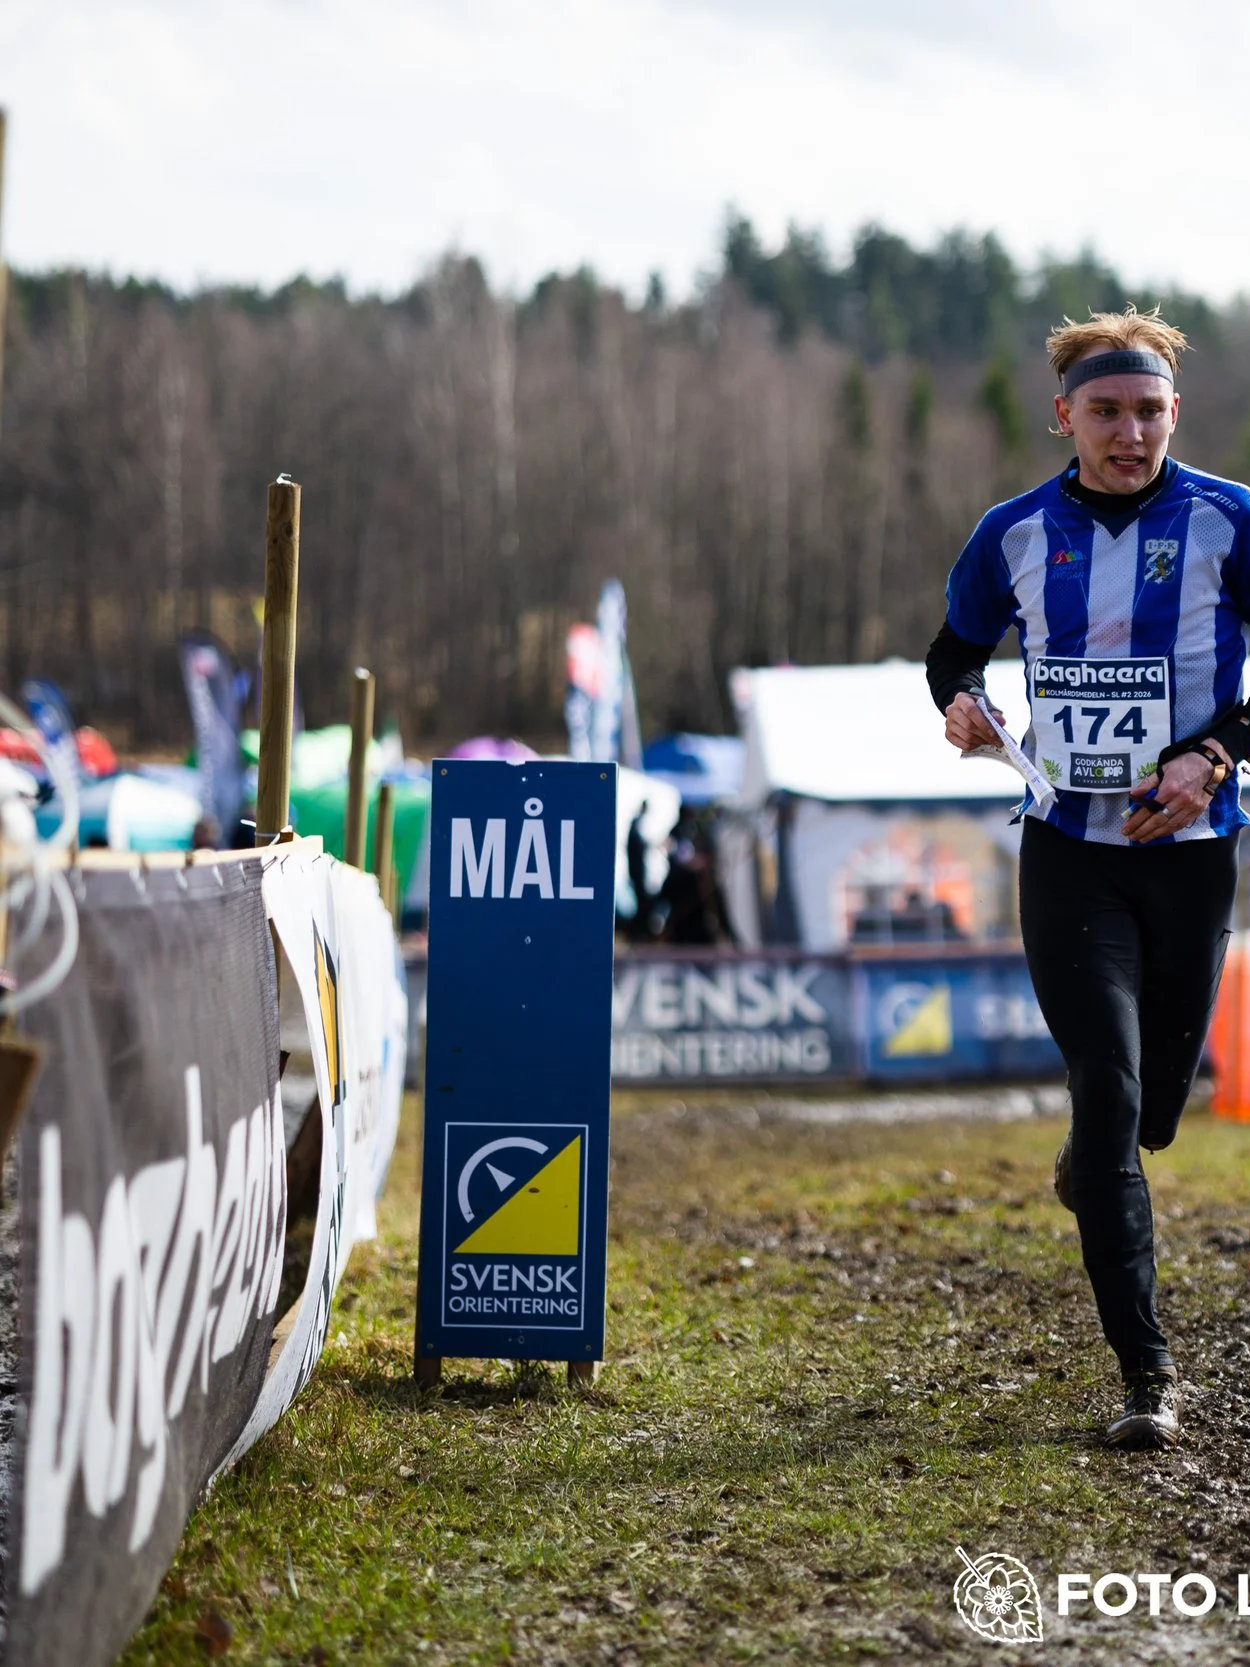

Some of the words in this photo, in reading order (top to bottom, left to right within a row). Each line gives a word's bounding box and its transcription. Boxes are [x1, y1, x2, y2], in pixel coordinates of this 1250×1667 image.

[1035, 661, 1163, 686] bagheera
[1046, 689, 1105, 698] KOLMÅRDSMEDELN
[1054, 705, 1147, 745] 174
[1074, 766, 1124, 778] AVLOPP
[1075, 758, 1124, 767] GODKÄNDA
[450, 797, 594, 900] MÅL
[613, 963, 827, 1029] VENSK
[450, 1263, 578, 1293] SVENSK
[449, 1296, 578, 1316] ORIENTERING
